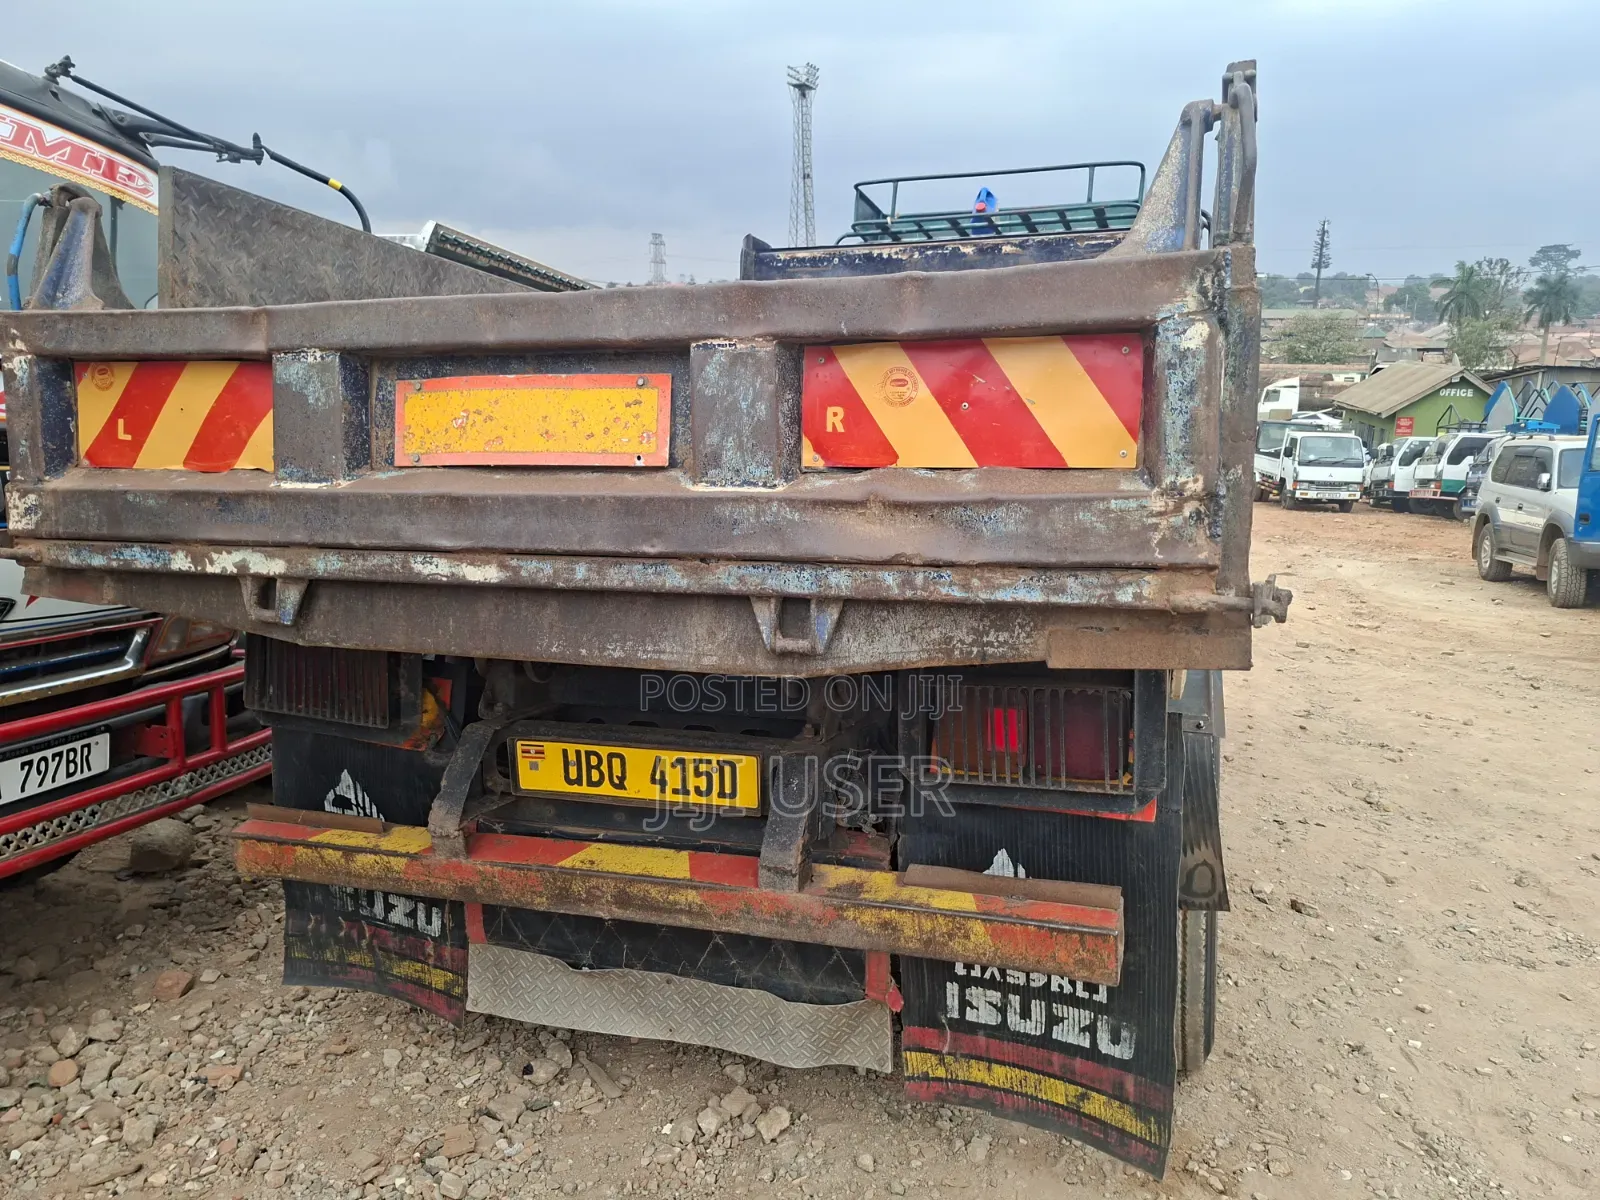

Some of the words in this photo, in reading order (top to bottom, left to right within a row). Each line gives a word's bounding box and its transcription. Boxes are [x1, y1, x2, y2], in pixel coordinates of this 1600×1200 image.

[0, 112, 155, 199] ME
[1440, 388, 1474, 397] OFFICE
[118, 418, 132, 441] L
[826, 406, 845, 433] R
[20, 742, 92, 794] 797BR
[562, 748, 627, 791] UBQ
[650, 755, 738, 800] 415D
[946, 981, 1137, 1061] ISUZU
